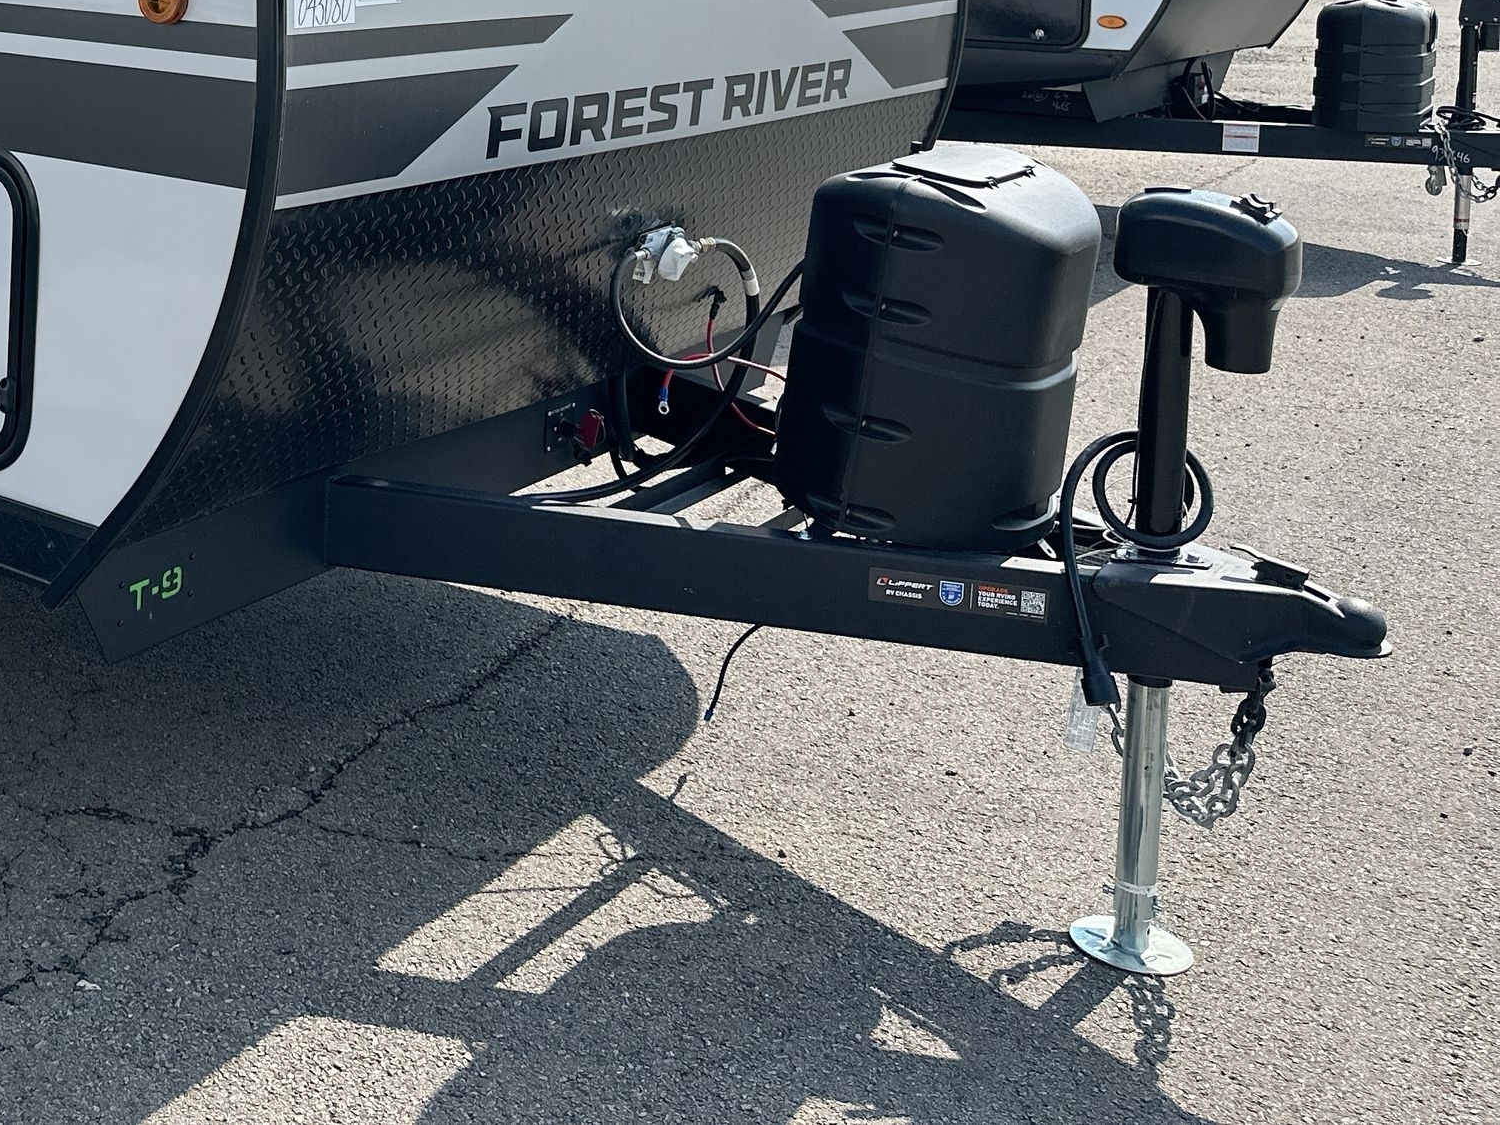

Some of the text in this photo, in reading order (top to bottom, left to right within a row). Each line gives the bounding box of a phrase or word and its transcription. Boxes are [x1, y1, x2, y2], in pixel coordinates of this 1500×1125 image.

[485, 58, 852, 160] FOREST RIVER
[888, 579, 935, 591] LIPPERT
[885, 588, 923, 599] RV CHASSIS
[978, 590, 995, 598] YOUR
[977, 595, 1018, 607] EXPERIENCE
